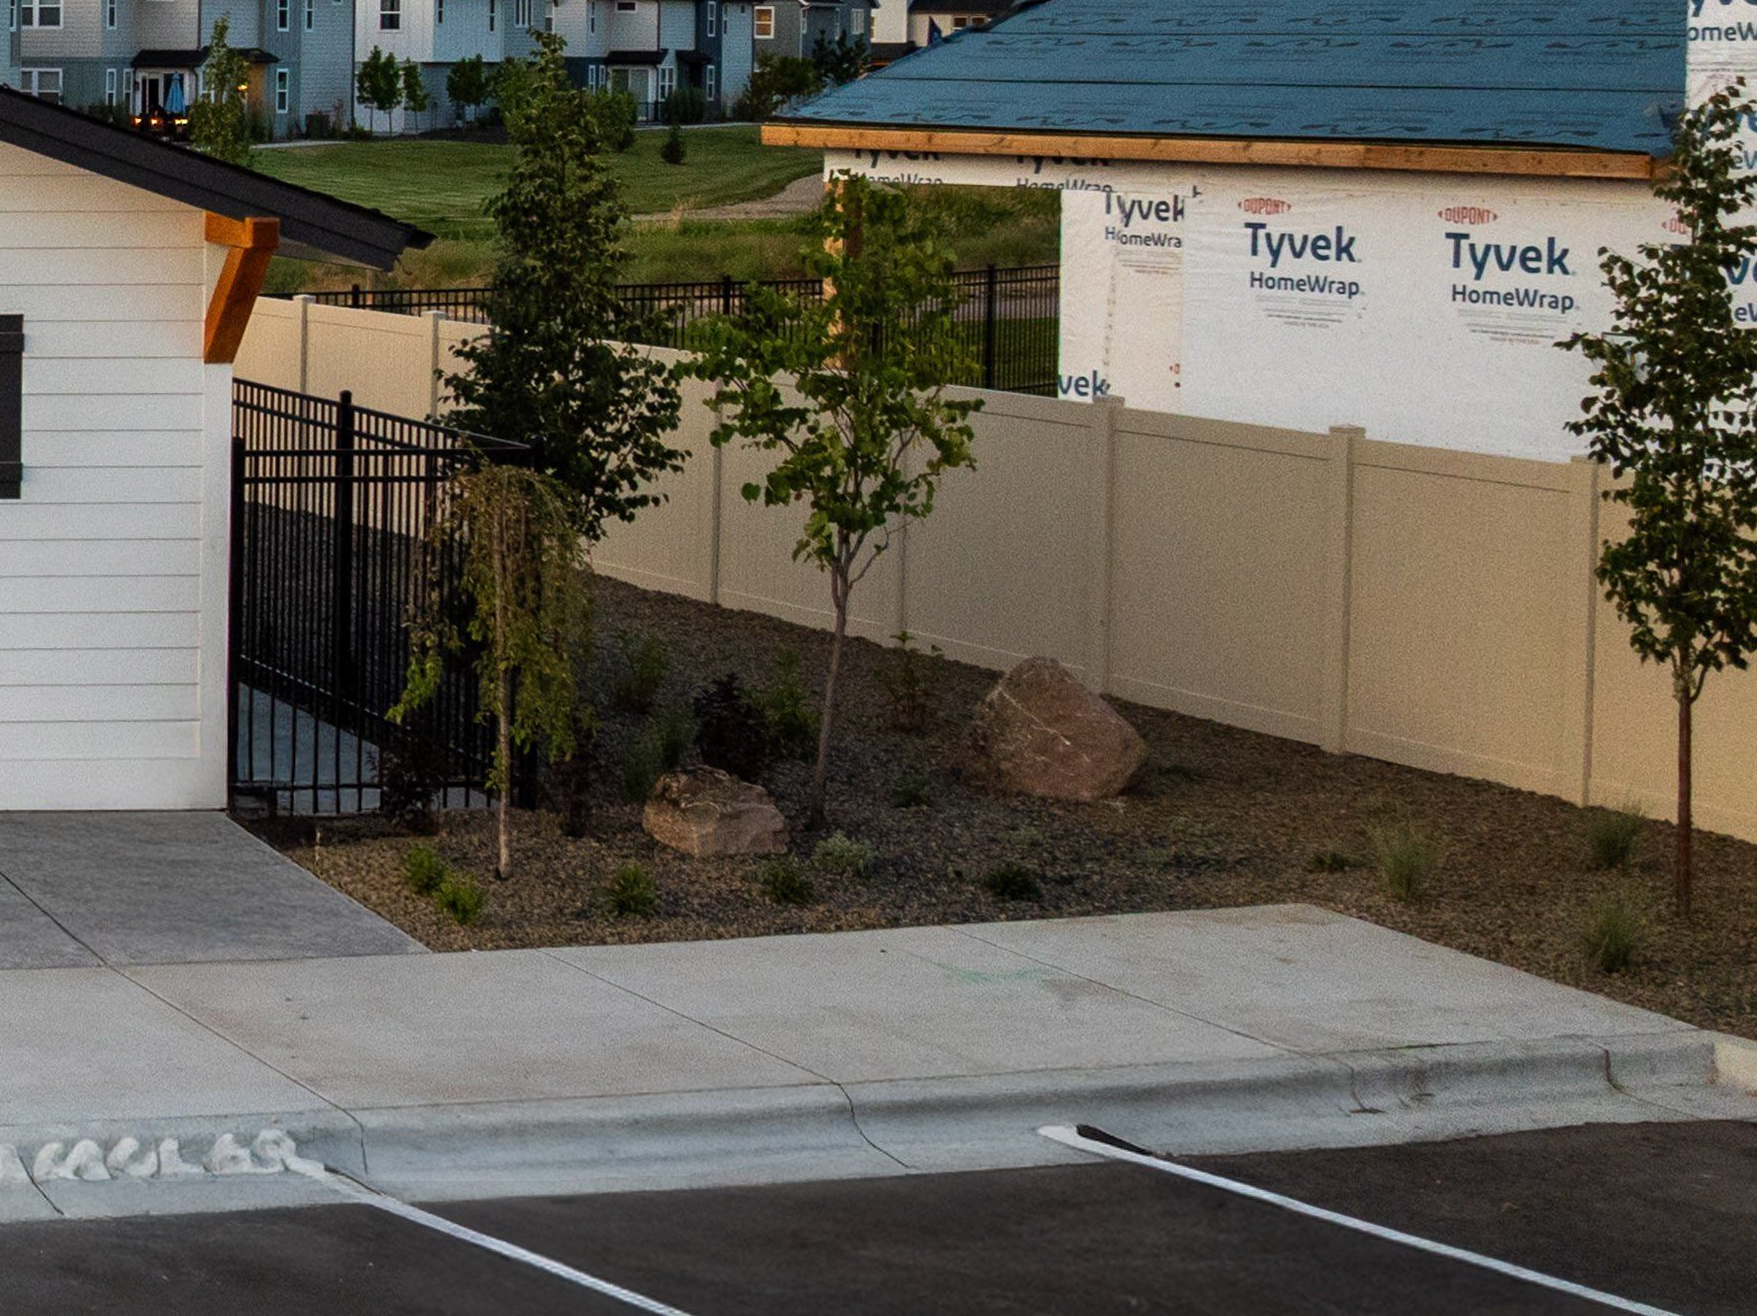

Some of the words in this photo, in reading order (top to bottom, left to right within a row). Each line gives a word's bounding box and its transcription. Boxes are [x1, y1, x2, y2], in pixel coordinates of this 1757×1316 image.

[1445, 206, 1491, 225] DUPONT
[1244, 222, 1357, 268] Tyvek
[1445, 232, 1571, 281] Tyvek
[1250, 271, 1360, 299] HomeWrap
[1452, 284, 1574, 314] HomeWrap
